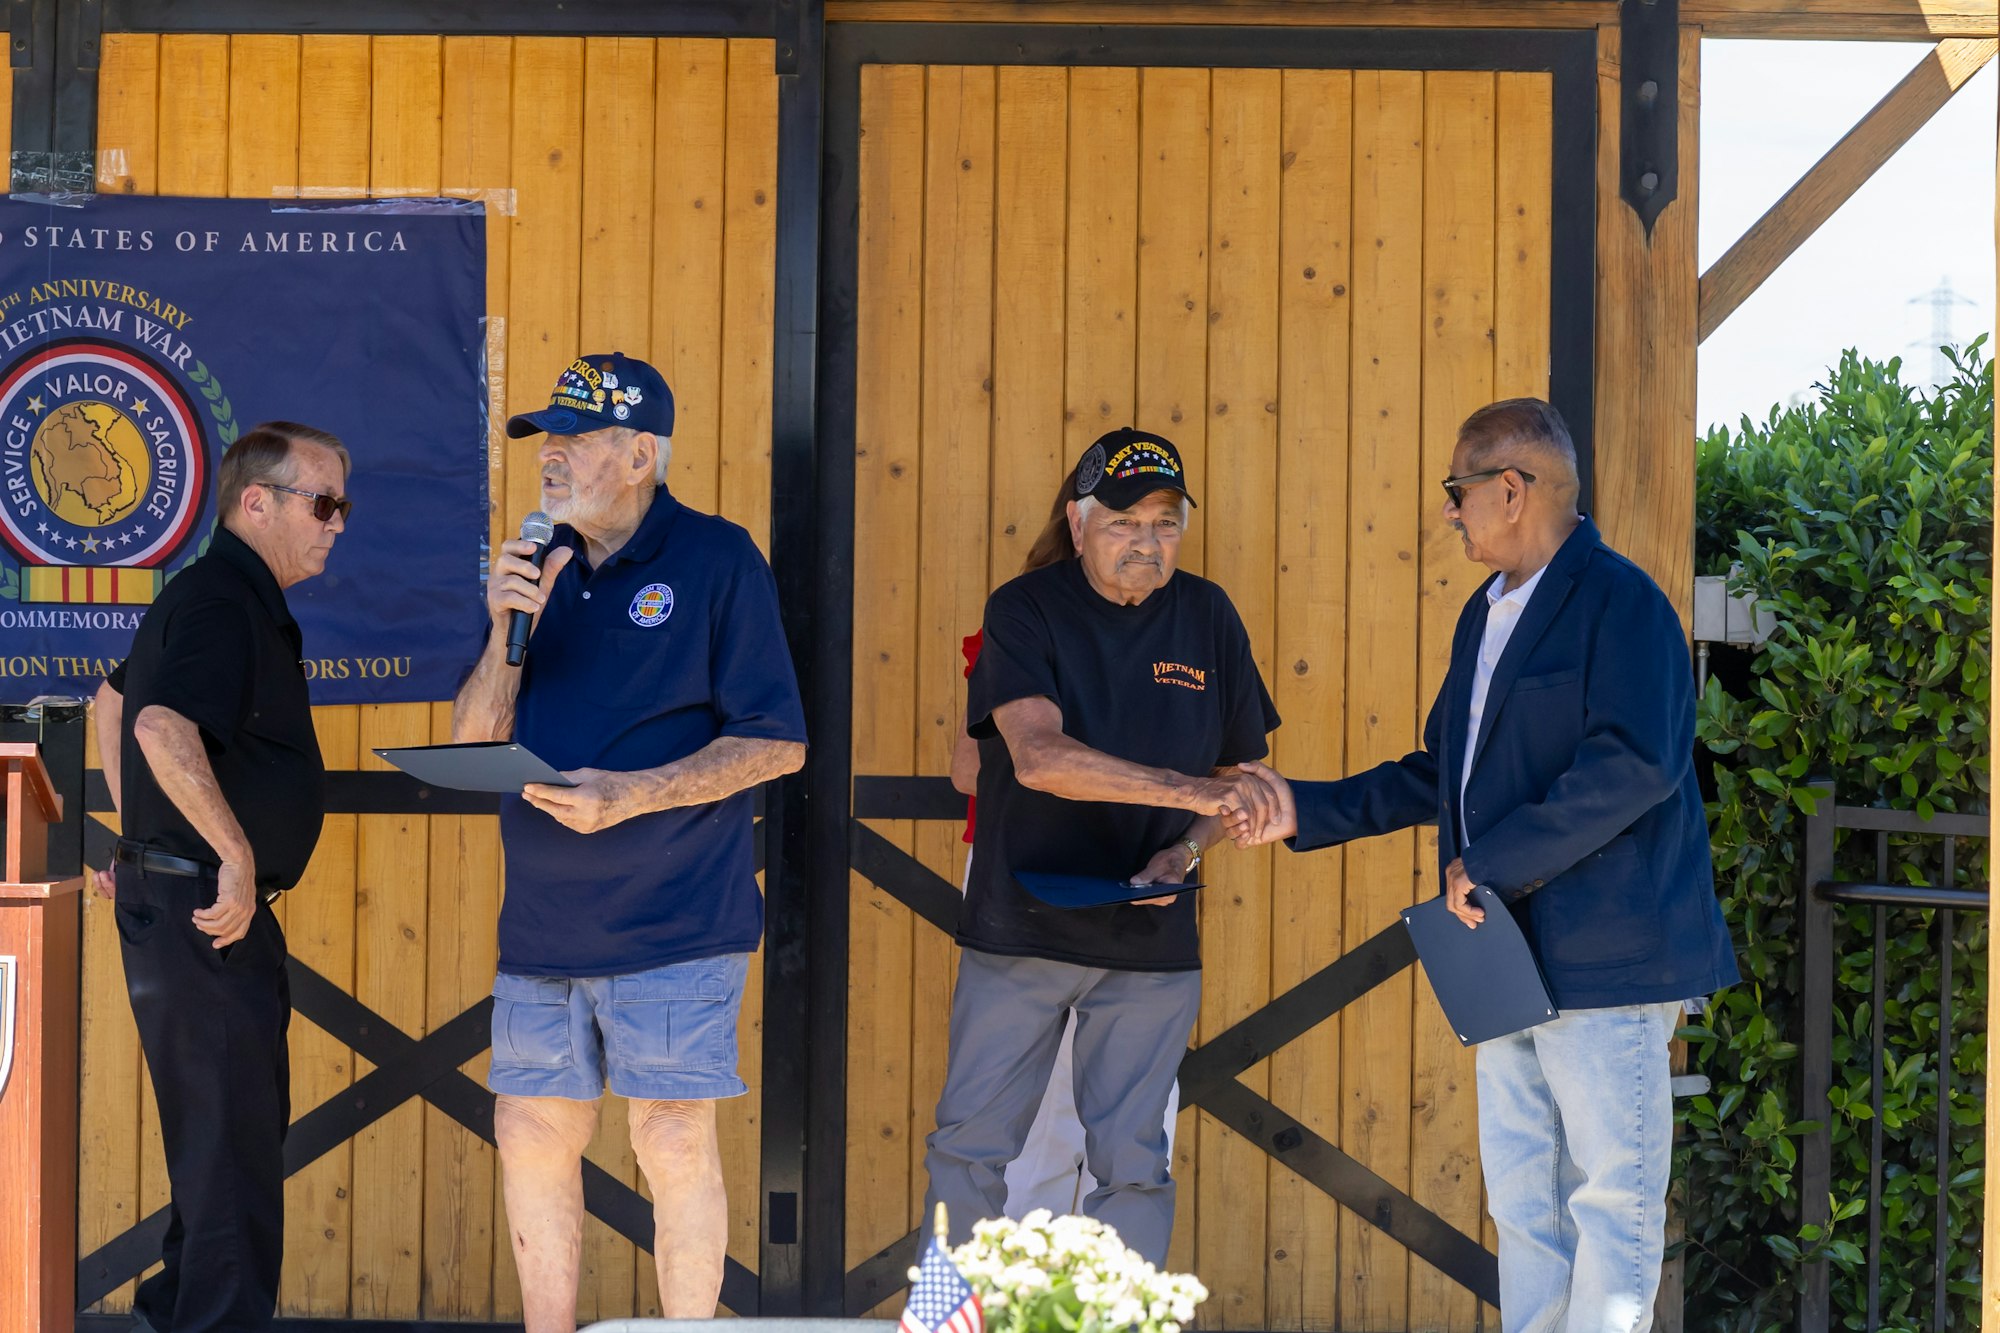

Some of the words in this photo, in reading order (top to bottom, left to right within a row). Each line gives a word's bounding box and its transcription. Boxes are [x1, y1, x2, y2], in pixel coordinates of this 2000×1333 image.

[24, 226, 154, 250] STATES
[175, 231, 220, 252] OF
[240, 231, 408, 253] AMERICA
[30, 279, 193, 331] ANNIVERSARY
[0, 305, 124, 354] IETNAM
[134, 314, 192, 371] WAR
[45, 373, 128, 401] VALOR
[570, 359, 602, 390] ORCE
[4, 415, 37, 517] SERVICE
[146, 416, 177, 520] SACRIFICE
[1105, 445, 1133, 476] ARMY
[1133, 442, 1180, 472] VETERAN
[0, 611, 145, 630] OMMEMORA
[301, 658, 350, 680] ORS
[355, 656, 411, 678] YOU
[1153, 661, 1205, 684] VIETNAM
[1154, 677, 1205, 690] VETERAN
